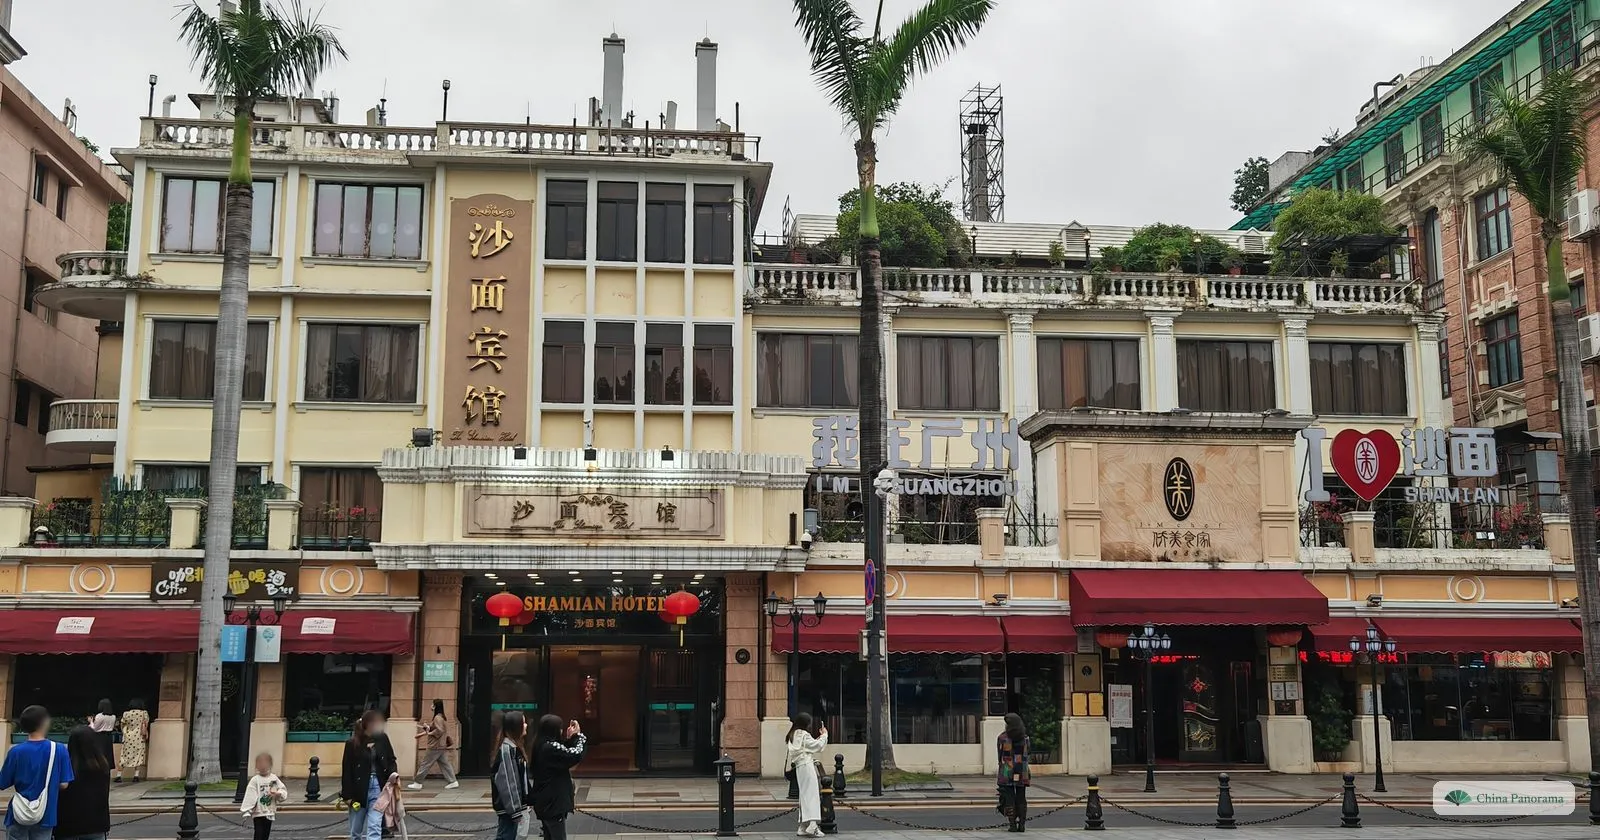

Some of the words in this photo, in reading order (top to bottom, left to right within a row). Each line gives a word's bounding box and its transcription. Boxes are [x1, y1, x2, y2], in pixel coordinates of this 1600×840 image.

[462, 219, 515, 428] 沙面宾馆
[1400, 426, 1499, 478] 沙面
[816, 475, 850, 494] I'M
[891, 477, 1019, 497] GUANGZHOU
[1404, 486, 1500, 504] SHAMIAN
[511, 500, 678, 524] 沙面宾馆
[248, 568, 287, 586] 啤酒
[155, 579, 188, 596] Coffee
[523, 595, 606, 612] SHAMIAN
[573, 618, 616, 628] 沙面宾馆
